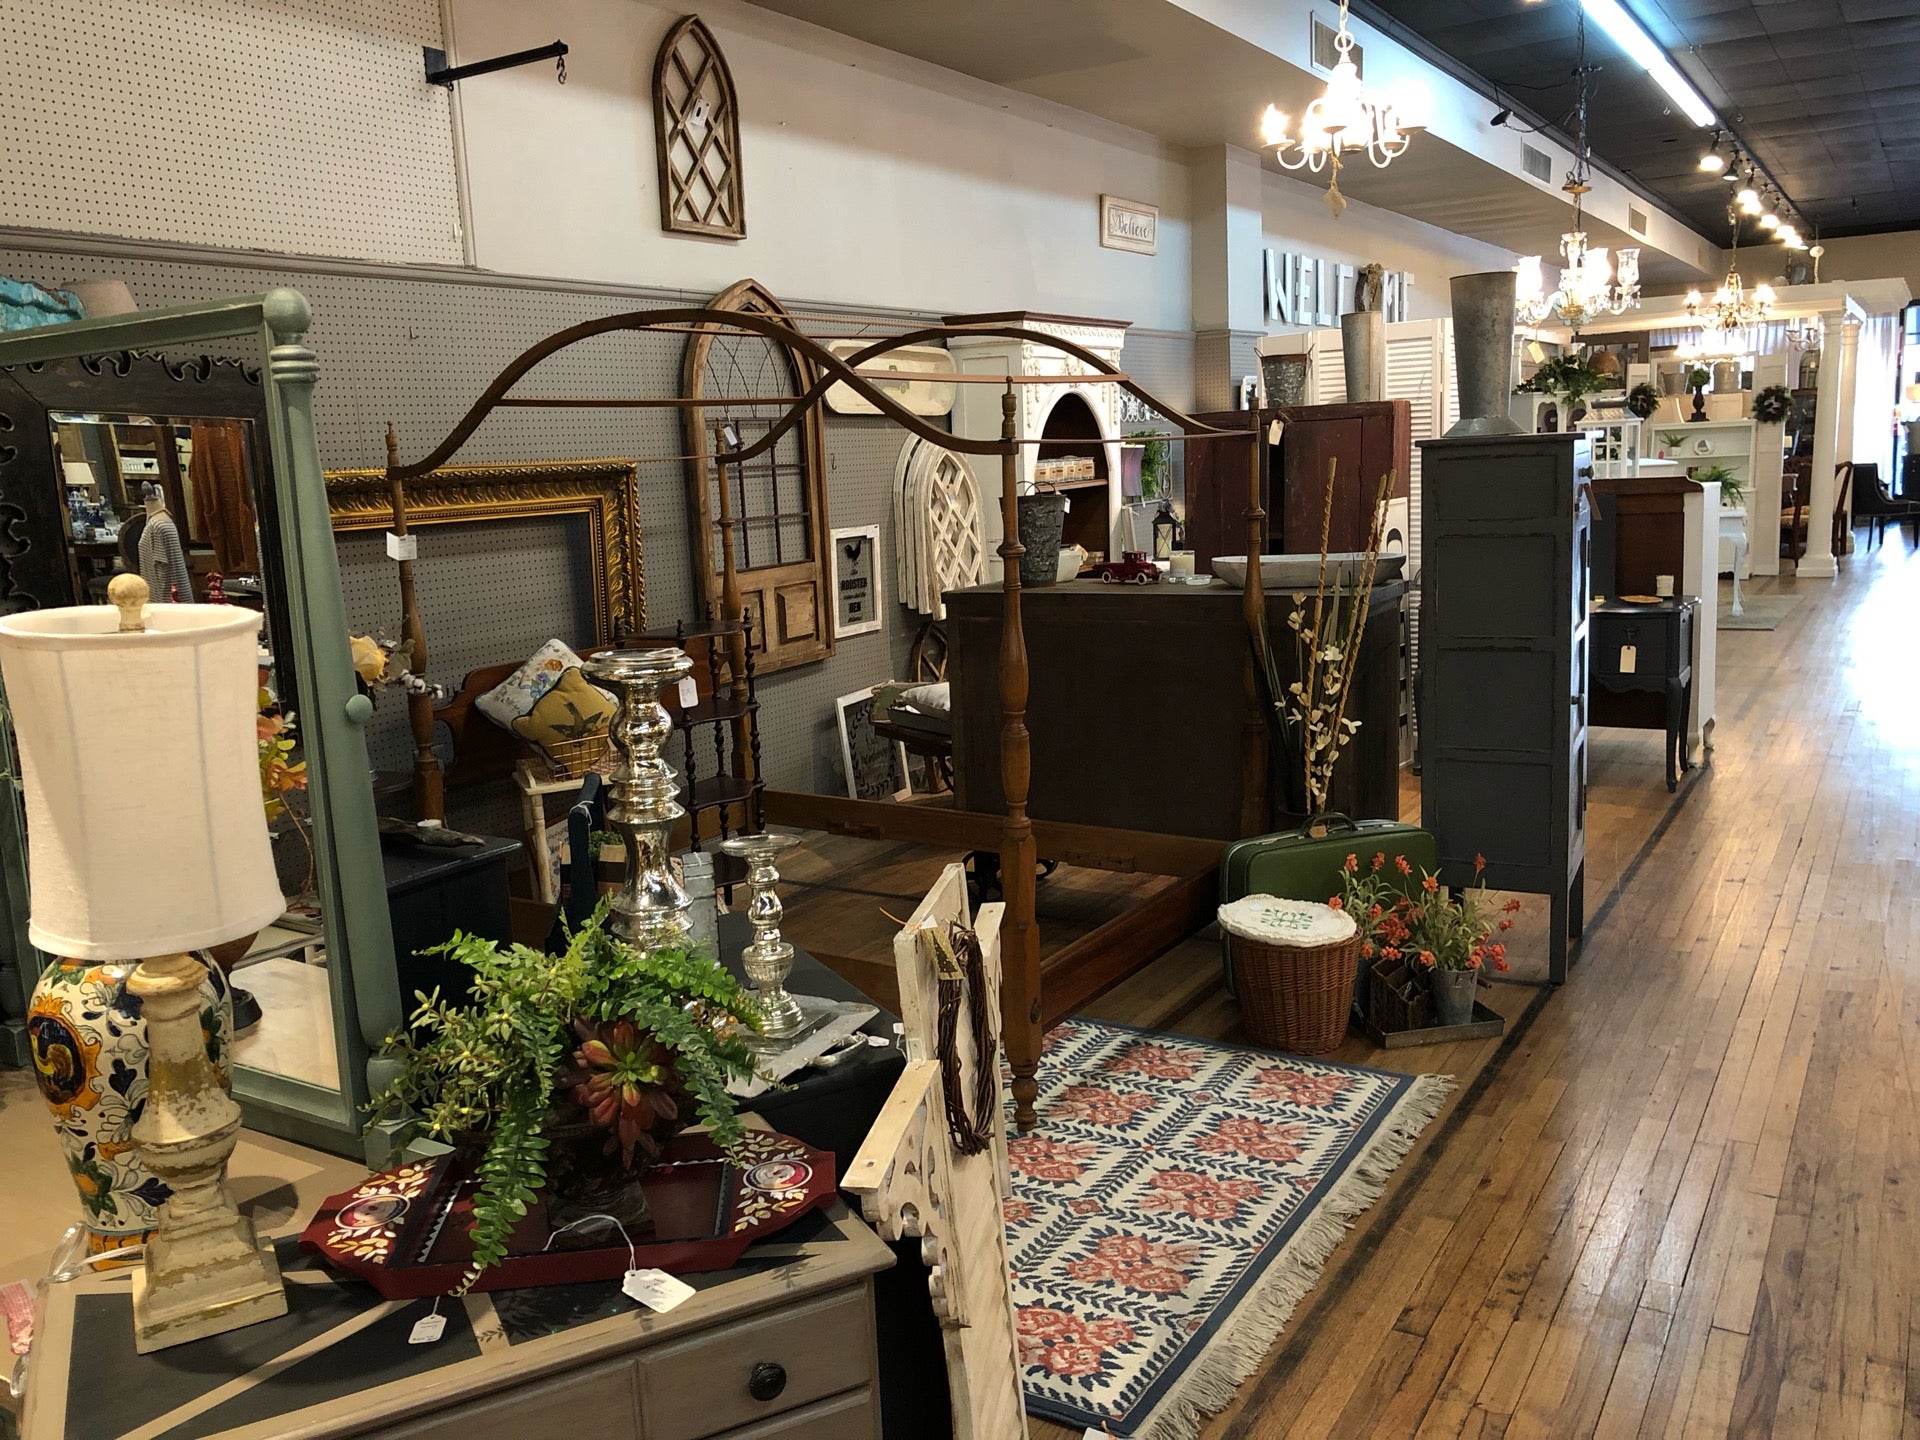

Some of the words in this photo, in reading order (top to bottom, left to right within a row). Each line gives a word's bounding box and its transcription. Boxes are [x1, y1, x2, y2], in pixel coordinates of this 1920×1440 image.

[1115, 213, 1148, 239] Believe
[840, 577, 868, 591] ROOSTER
[849, 602, 861, 613] HEN
